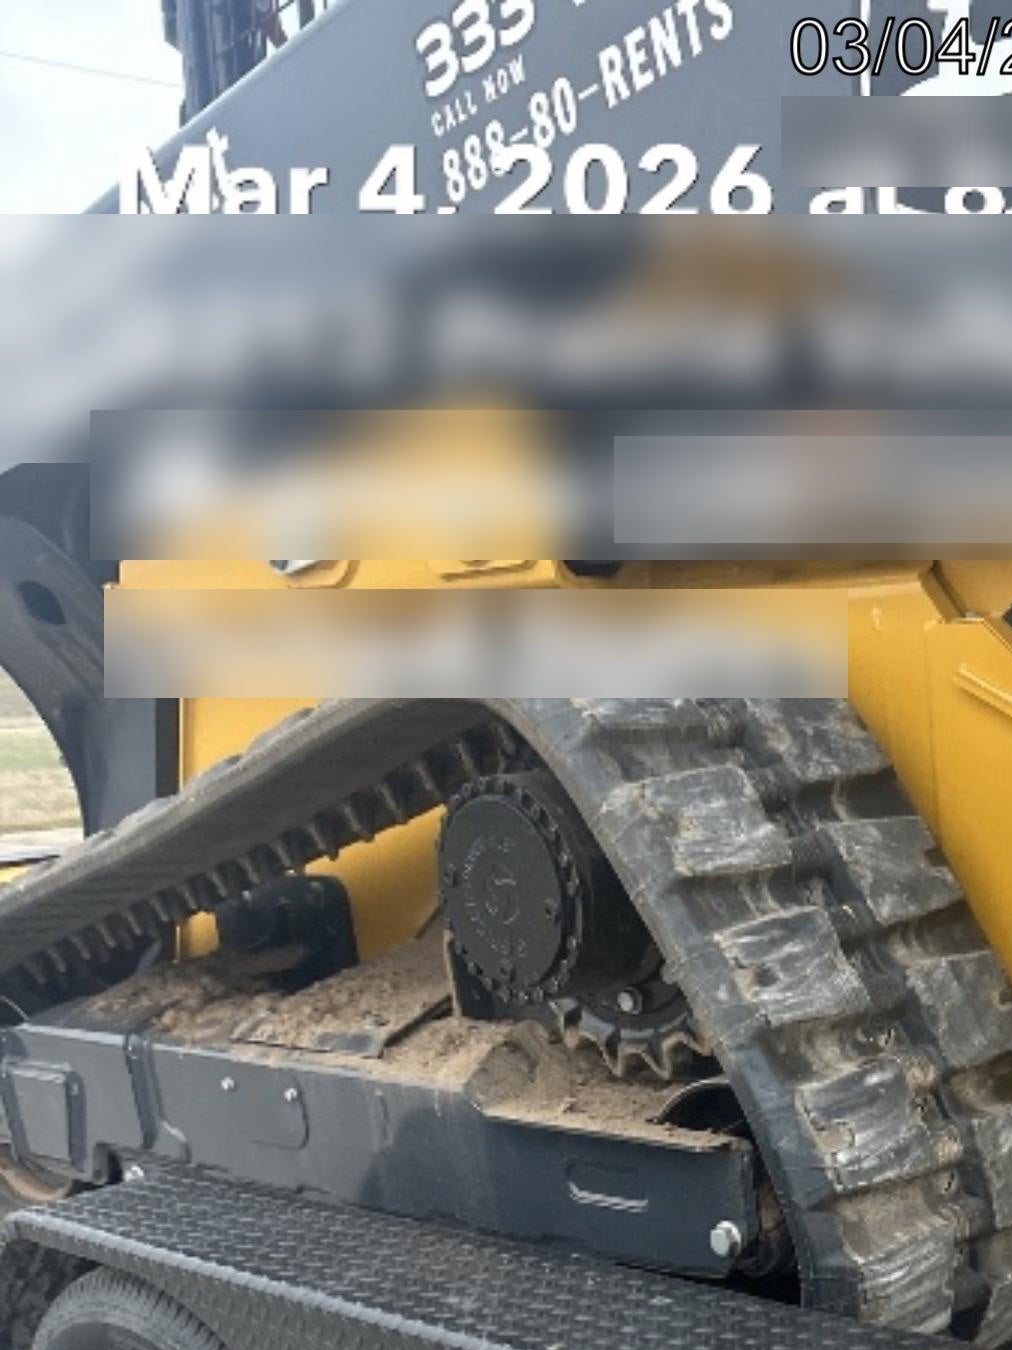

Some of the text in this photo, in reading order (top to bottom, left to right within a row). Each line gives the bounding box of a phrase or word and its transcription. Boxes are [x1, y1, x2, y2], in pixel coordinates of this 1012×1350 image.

[416, 0, 536, 97] 333
[430, 53, 527, 138] CALL NOW
